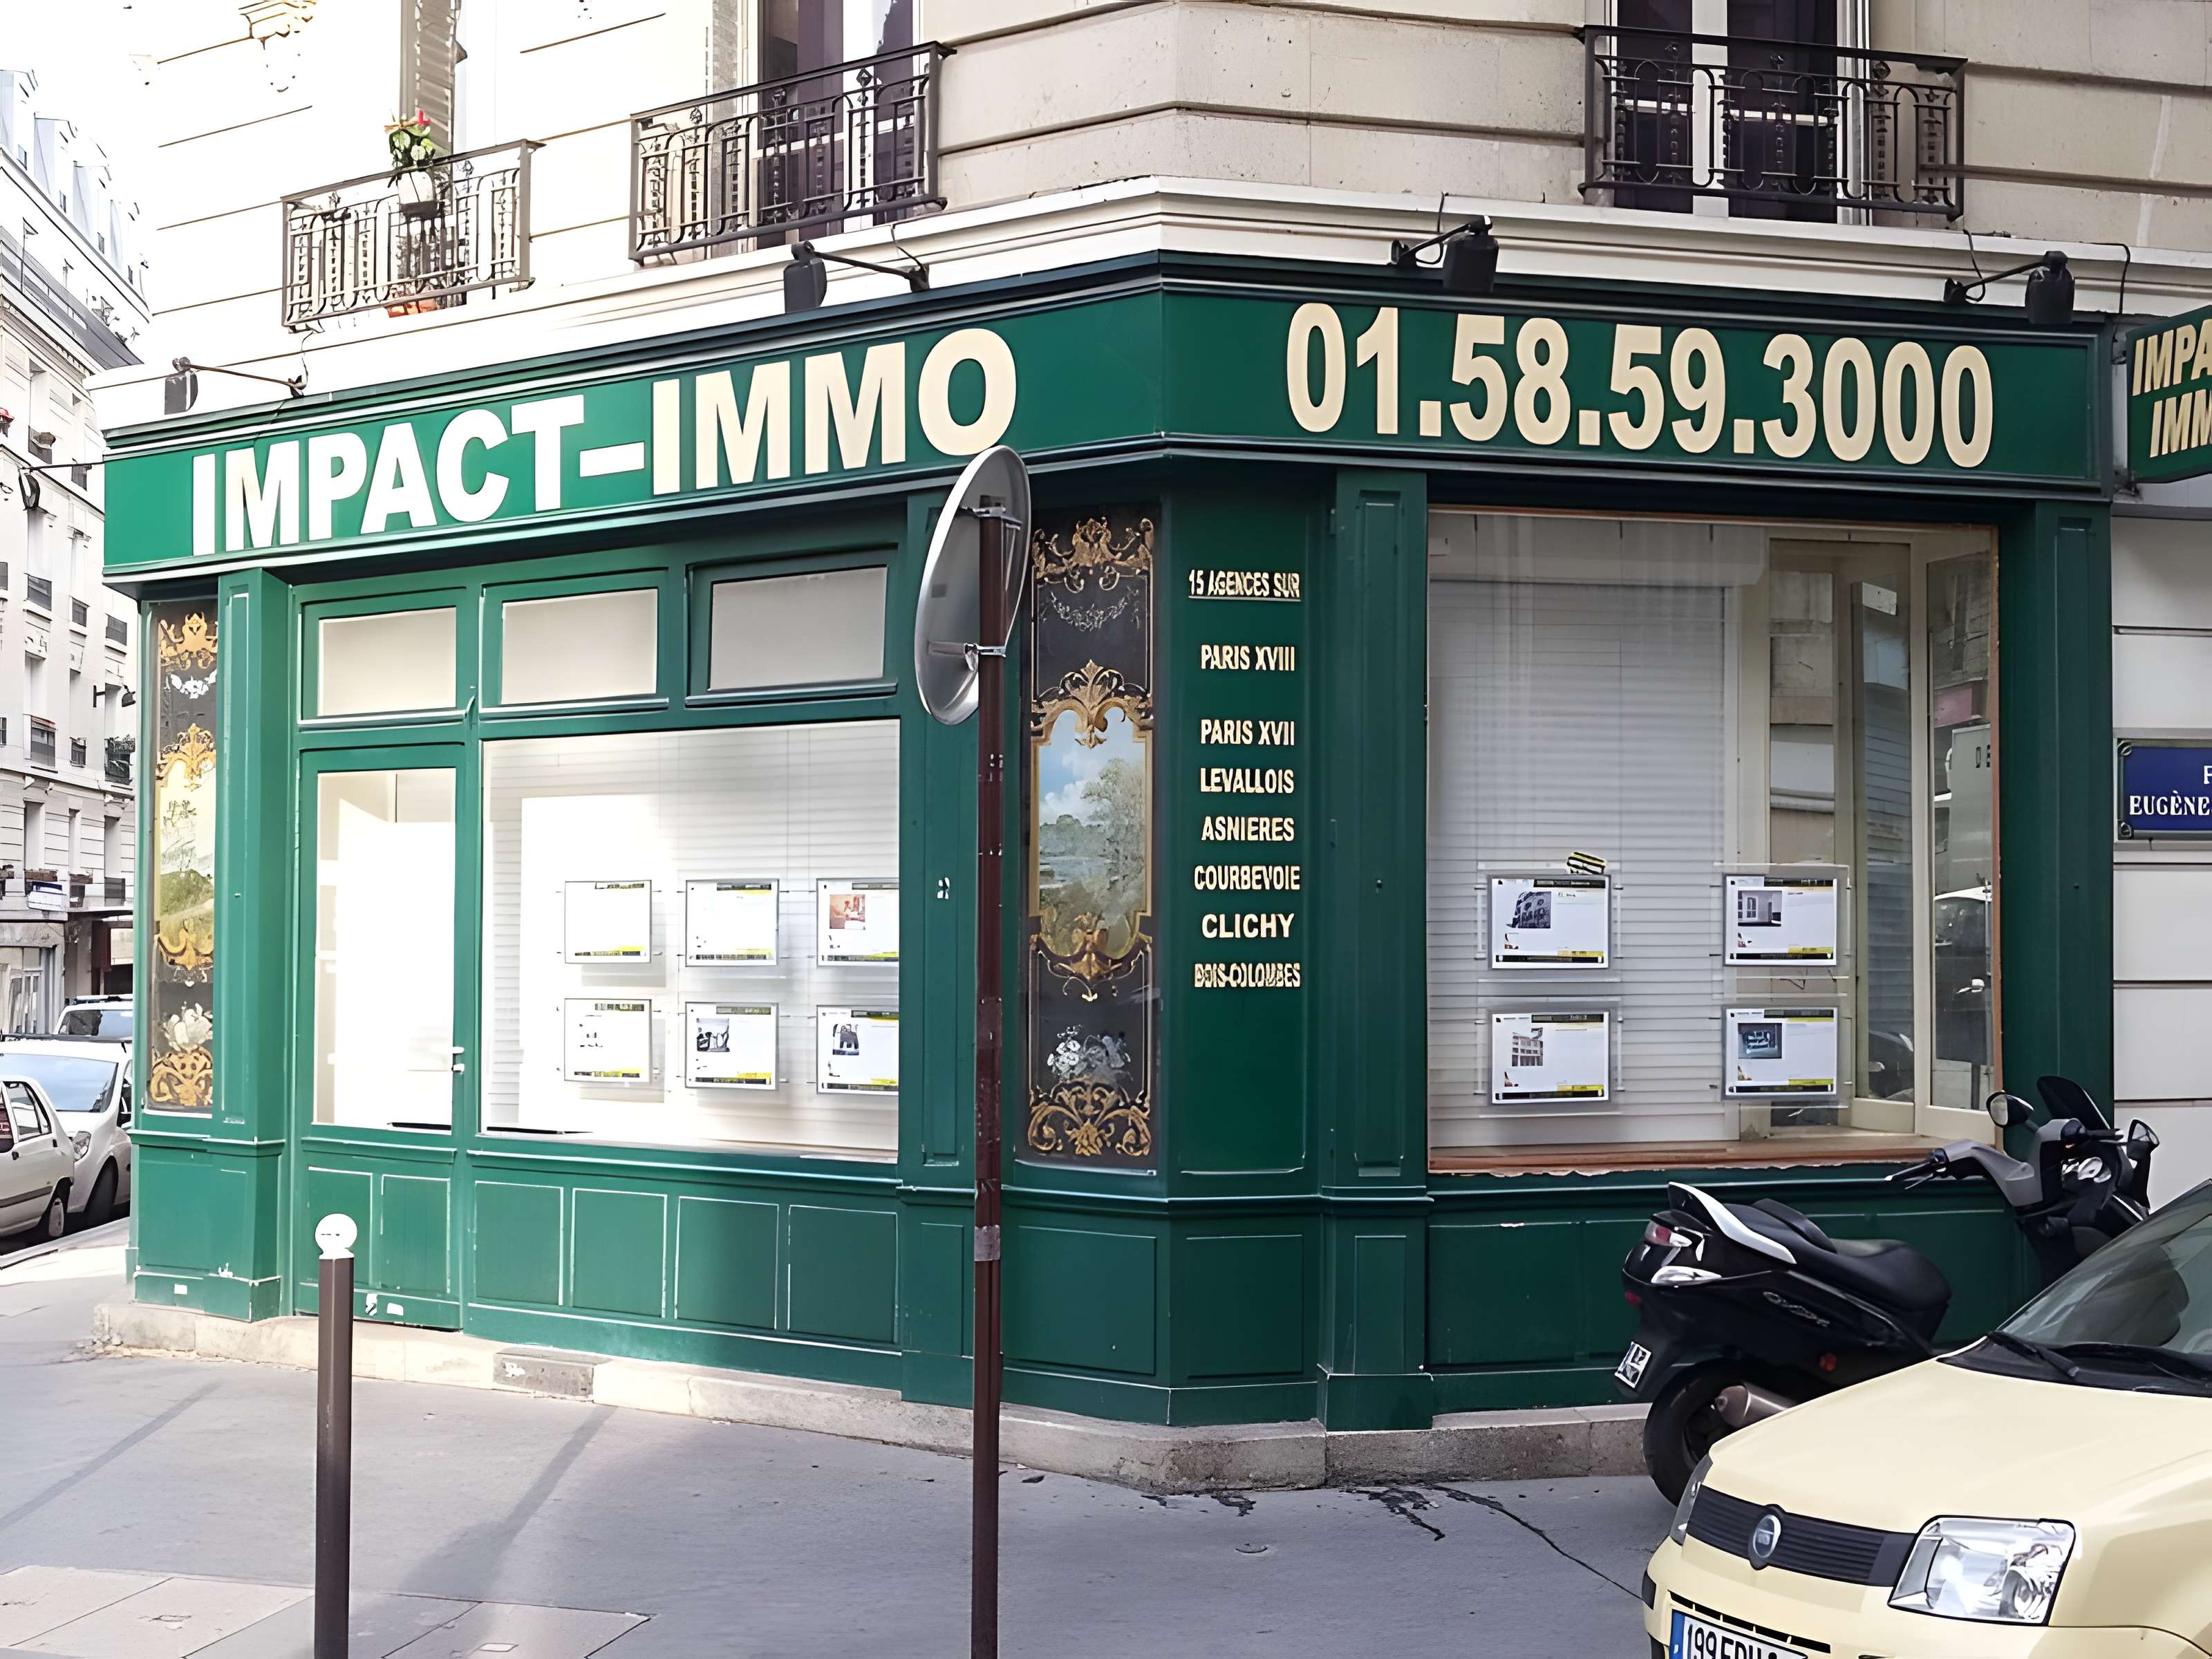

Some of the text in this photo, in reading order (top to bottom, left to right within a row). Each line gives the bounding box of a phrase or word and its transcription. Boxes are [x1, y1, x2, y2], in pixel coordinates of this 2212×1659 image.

[1286, 302, 1994, 469] 01.58.59.3000
[191, 328, 1018, 557] IMPACT-IMMO
[1189, 569, 1300, 598] 15 AGENCES SUR
[1201, 644, 1295, 671] PARIS XVIII
[1201, 719, 1295, 746] PARIS XVII
[1200, 767, 1295, 794] LEVALLOIS
[1201, 816, 1295, 842] ASNIERES
[1194, 865, 1300, 890] COURBEVOIE
[1201, 912, 1295, 939] CLICHY
